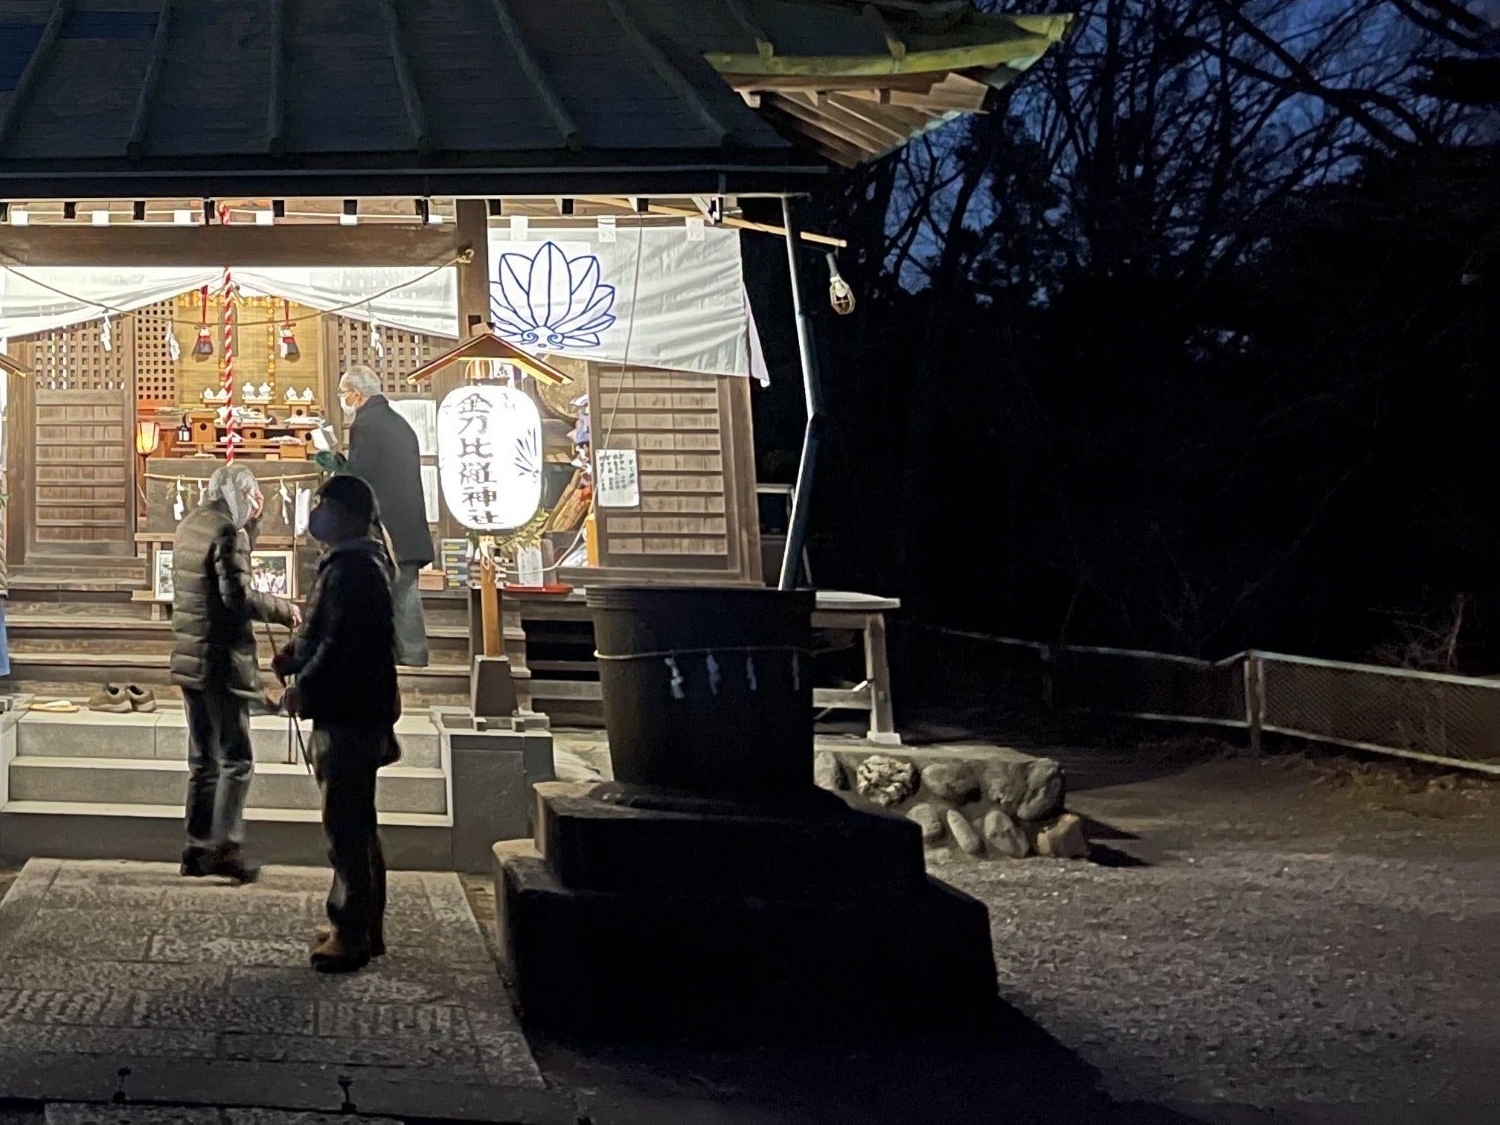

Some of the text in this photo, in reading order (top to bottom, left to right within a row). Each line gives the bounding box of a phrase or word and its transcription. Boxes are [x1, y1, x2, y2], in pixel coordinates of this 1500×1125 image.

[456, 392, 504, 525] 金刀比羅神社
